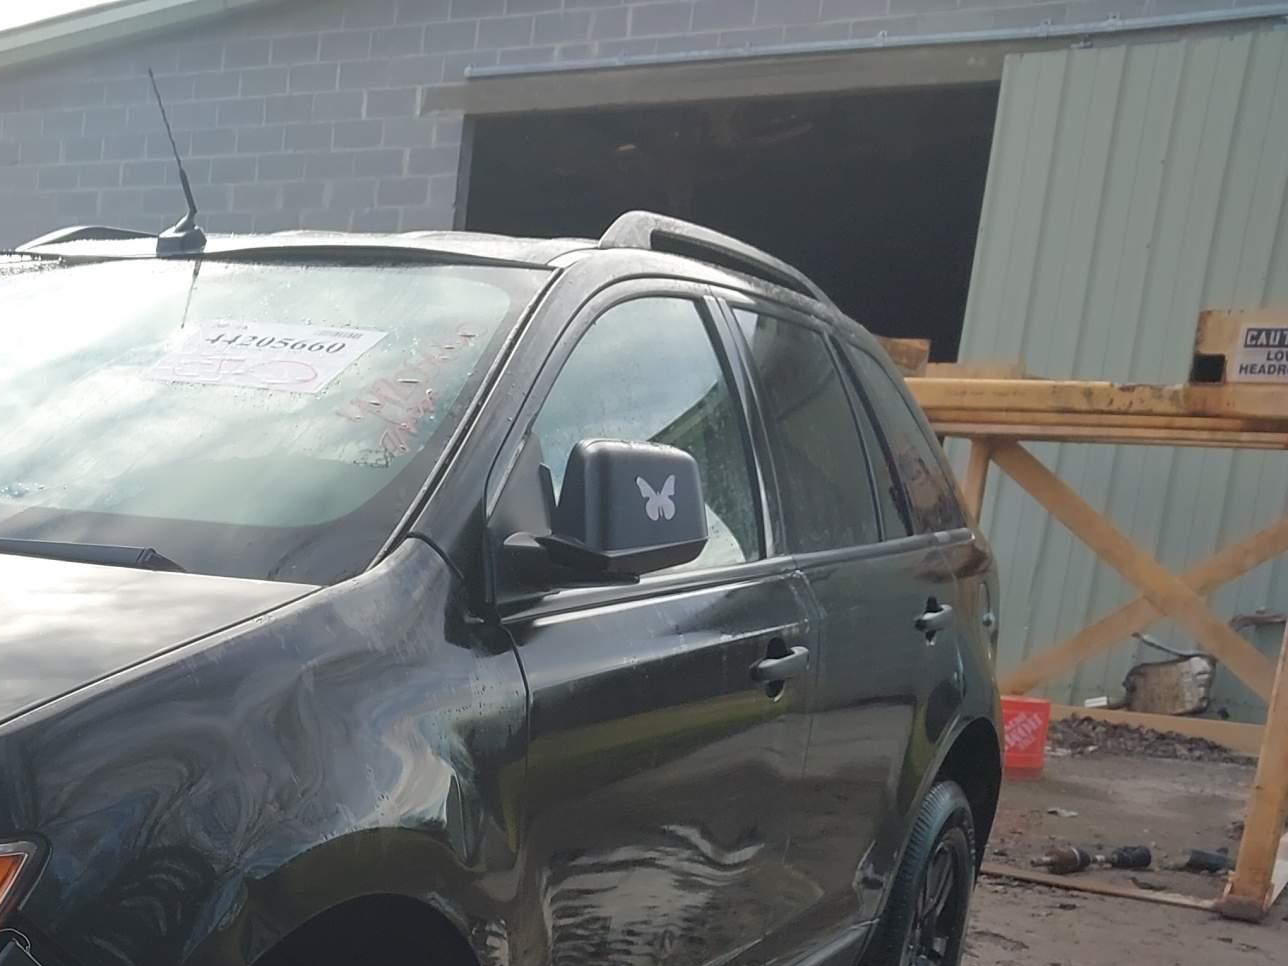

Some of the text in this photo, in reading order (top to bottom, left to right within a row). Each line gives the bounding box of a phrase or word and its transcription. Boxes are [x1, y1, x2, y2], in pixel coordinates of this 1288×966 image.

[205, 332, 347, 354] 44205660
[1266, 350, 1288, 361] LO
[1239, 363, 1288, 375] HEADR
